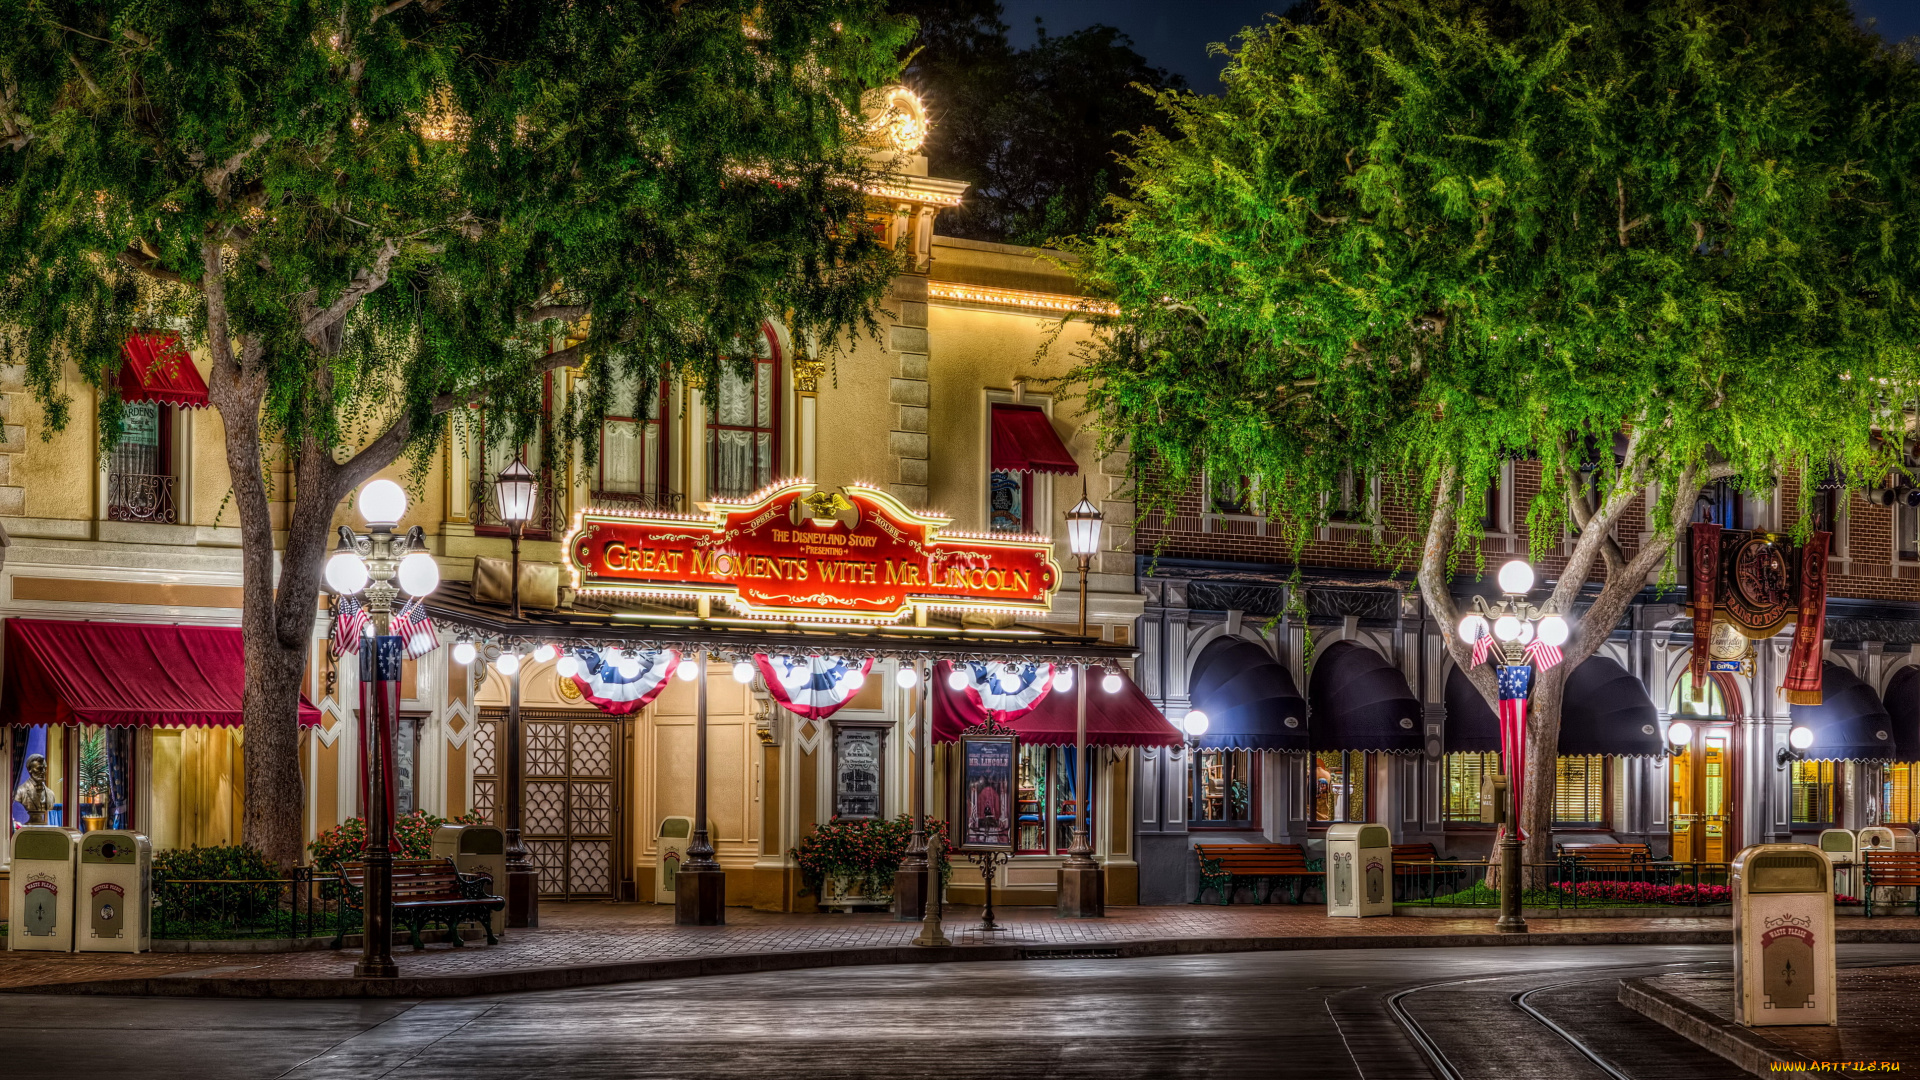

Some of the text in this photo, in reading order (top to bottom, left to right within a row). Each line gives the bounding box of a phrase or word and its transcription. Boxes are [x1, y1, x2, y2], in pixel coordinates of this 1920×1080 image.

[750, 511, 776, 528] OPERA
[874, 516, 900, 536] HOUSE
[772, 529, 877, 548] THE DISNEYLAND STORY
[806, 546, 844, 556] PRESENTING
[603, 541, 1030, 592] GREAT MOMENTS WITH MR. LINCOLN
[980, 758, 1008, 766] LINCOLN
[26, 882, 56, 890] WASTE PLEASE
[1769, 928, 1807, 938] WASTE PLEASE
